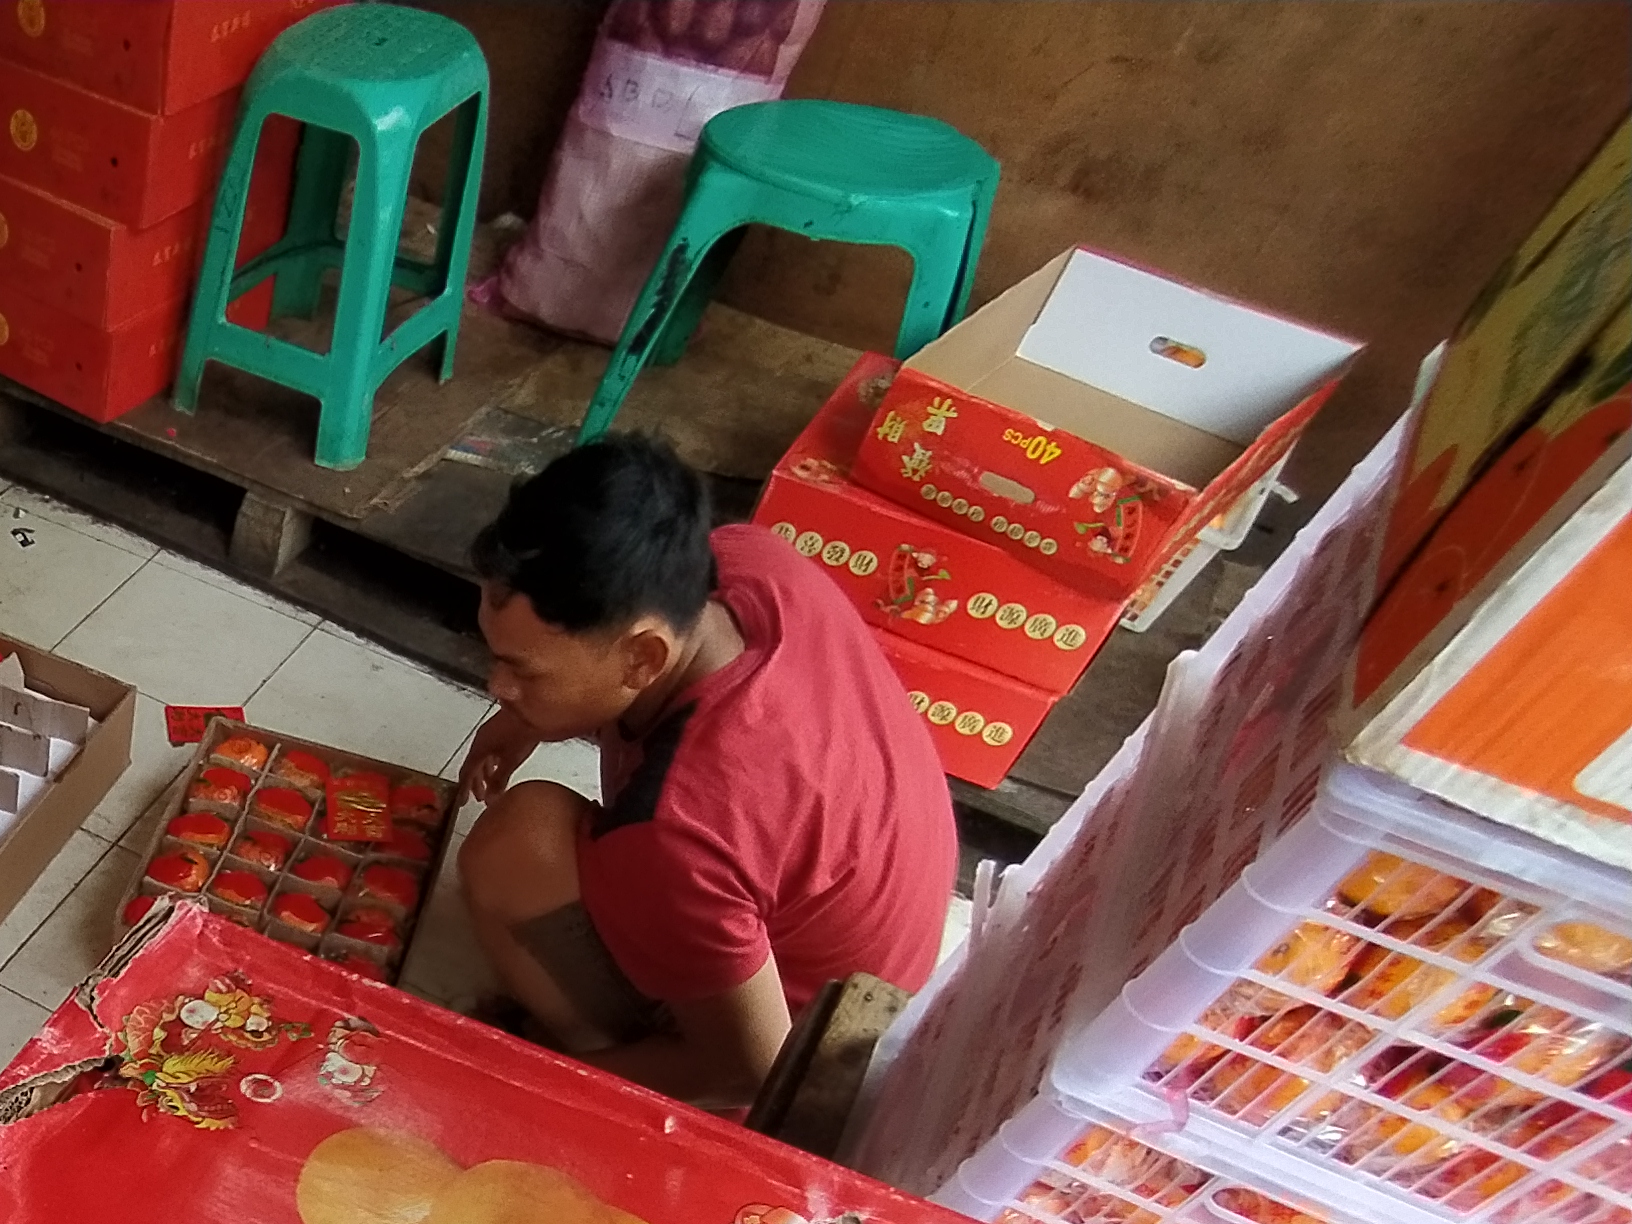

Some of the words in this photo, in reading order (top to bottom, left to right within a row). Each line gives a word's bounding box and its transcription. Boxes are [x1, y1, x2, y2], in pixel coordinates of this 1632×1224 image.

[876, 410, 907, 444] 財
[921, 396, 959, 436] 果
[969, 595, 1084, 648] 財源廣進
